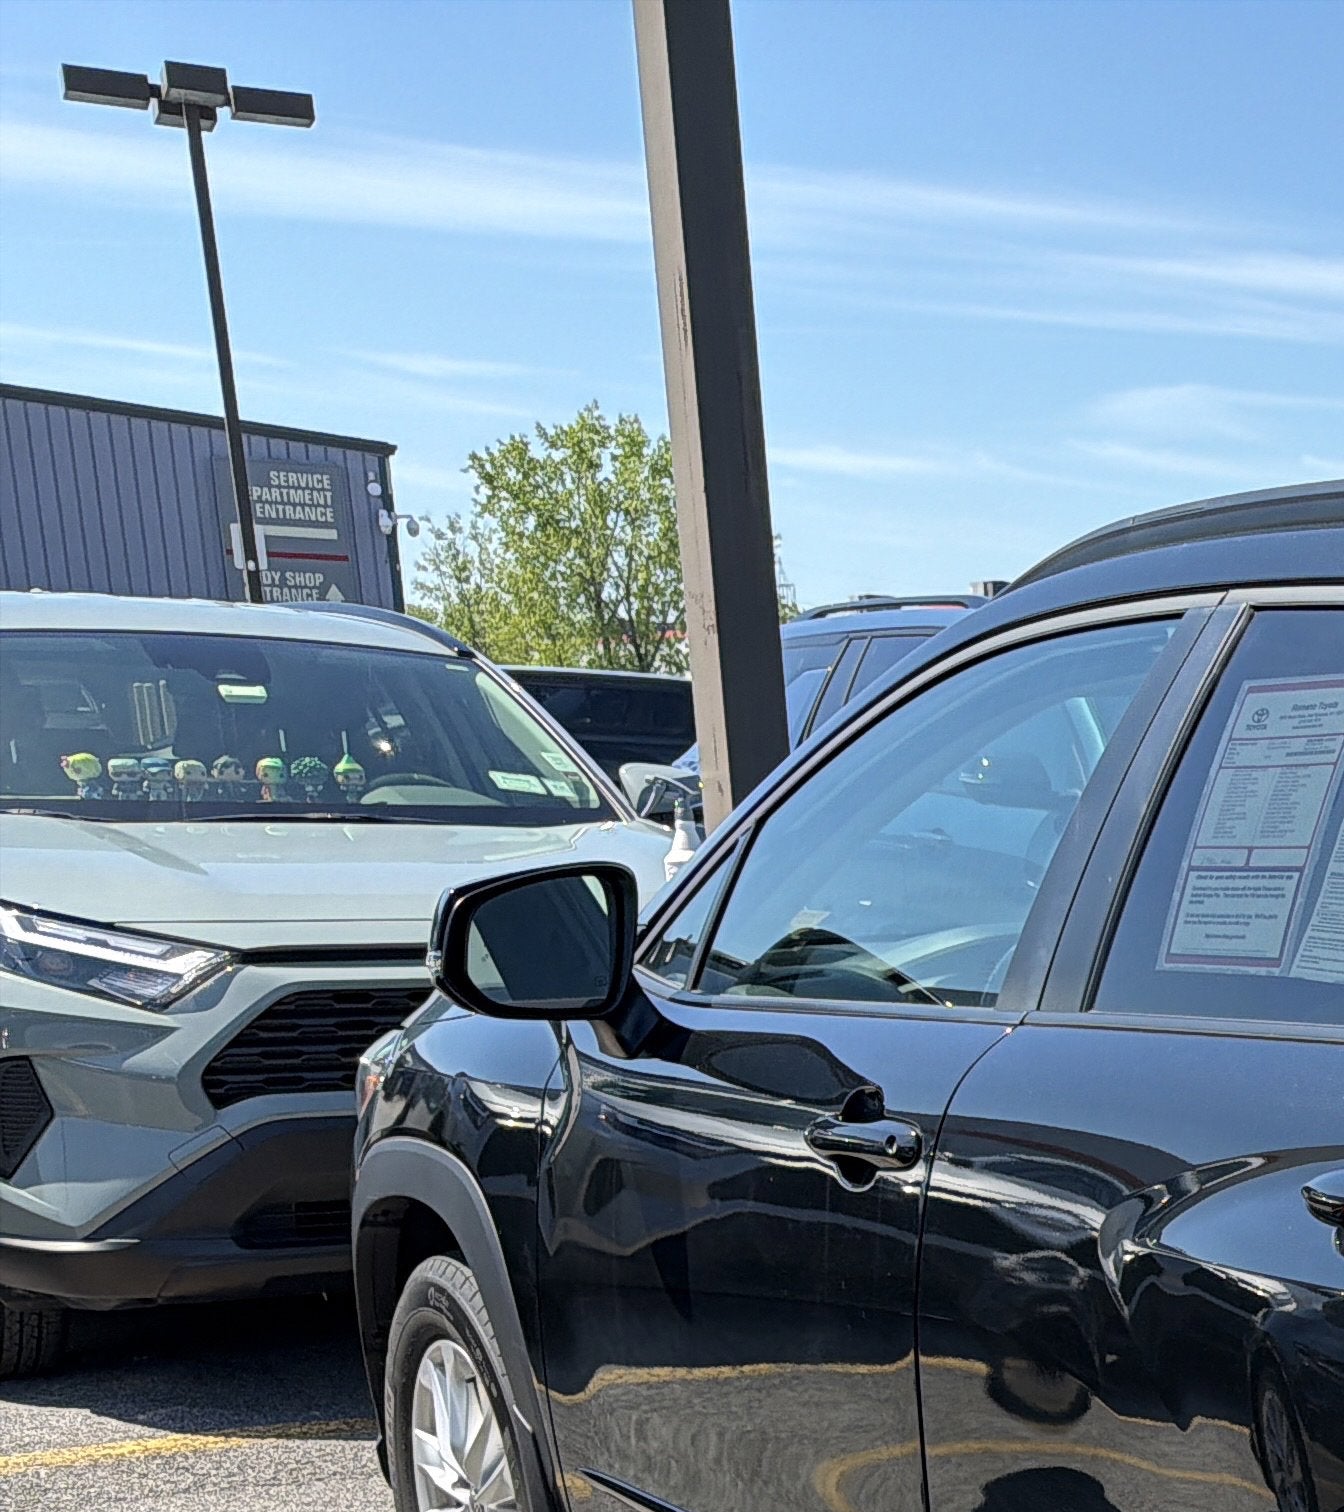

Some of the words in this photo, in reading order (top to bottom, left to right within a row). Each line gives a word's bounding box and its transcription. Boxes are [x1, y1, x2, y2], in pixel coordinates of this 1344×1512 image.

[270, 471, 332, 489] SERVICE
[249, 486, 333, 506] PARTMENT
[255, 503, 335, 522] ENTRANCE
[261, 570, 282, 585] DY
[286, 571, 324, 587] SHOP
[263, 586, 320, 602] TRANCE
